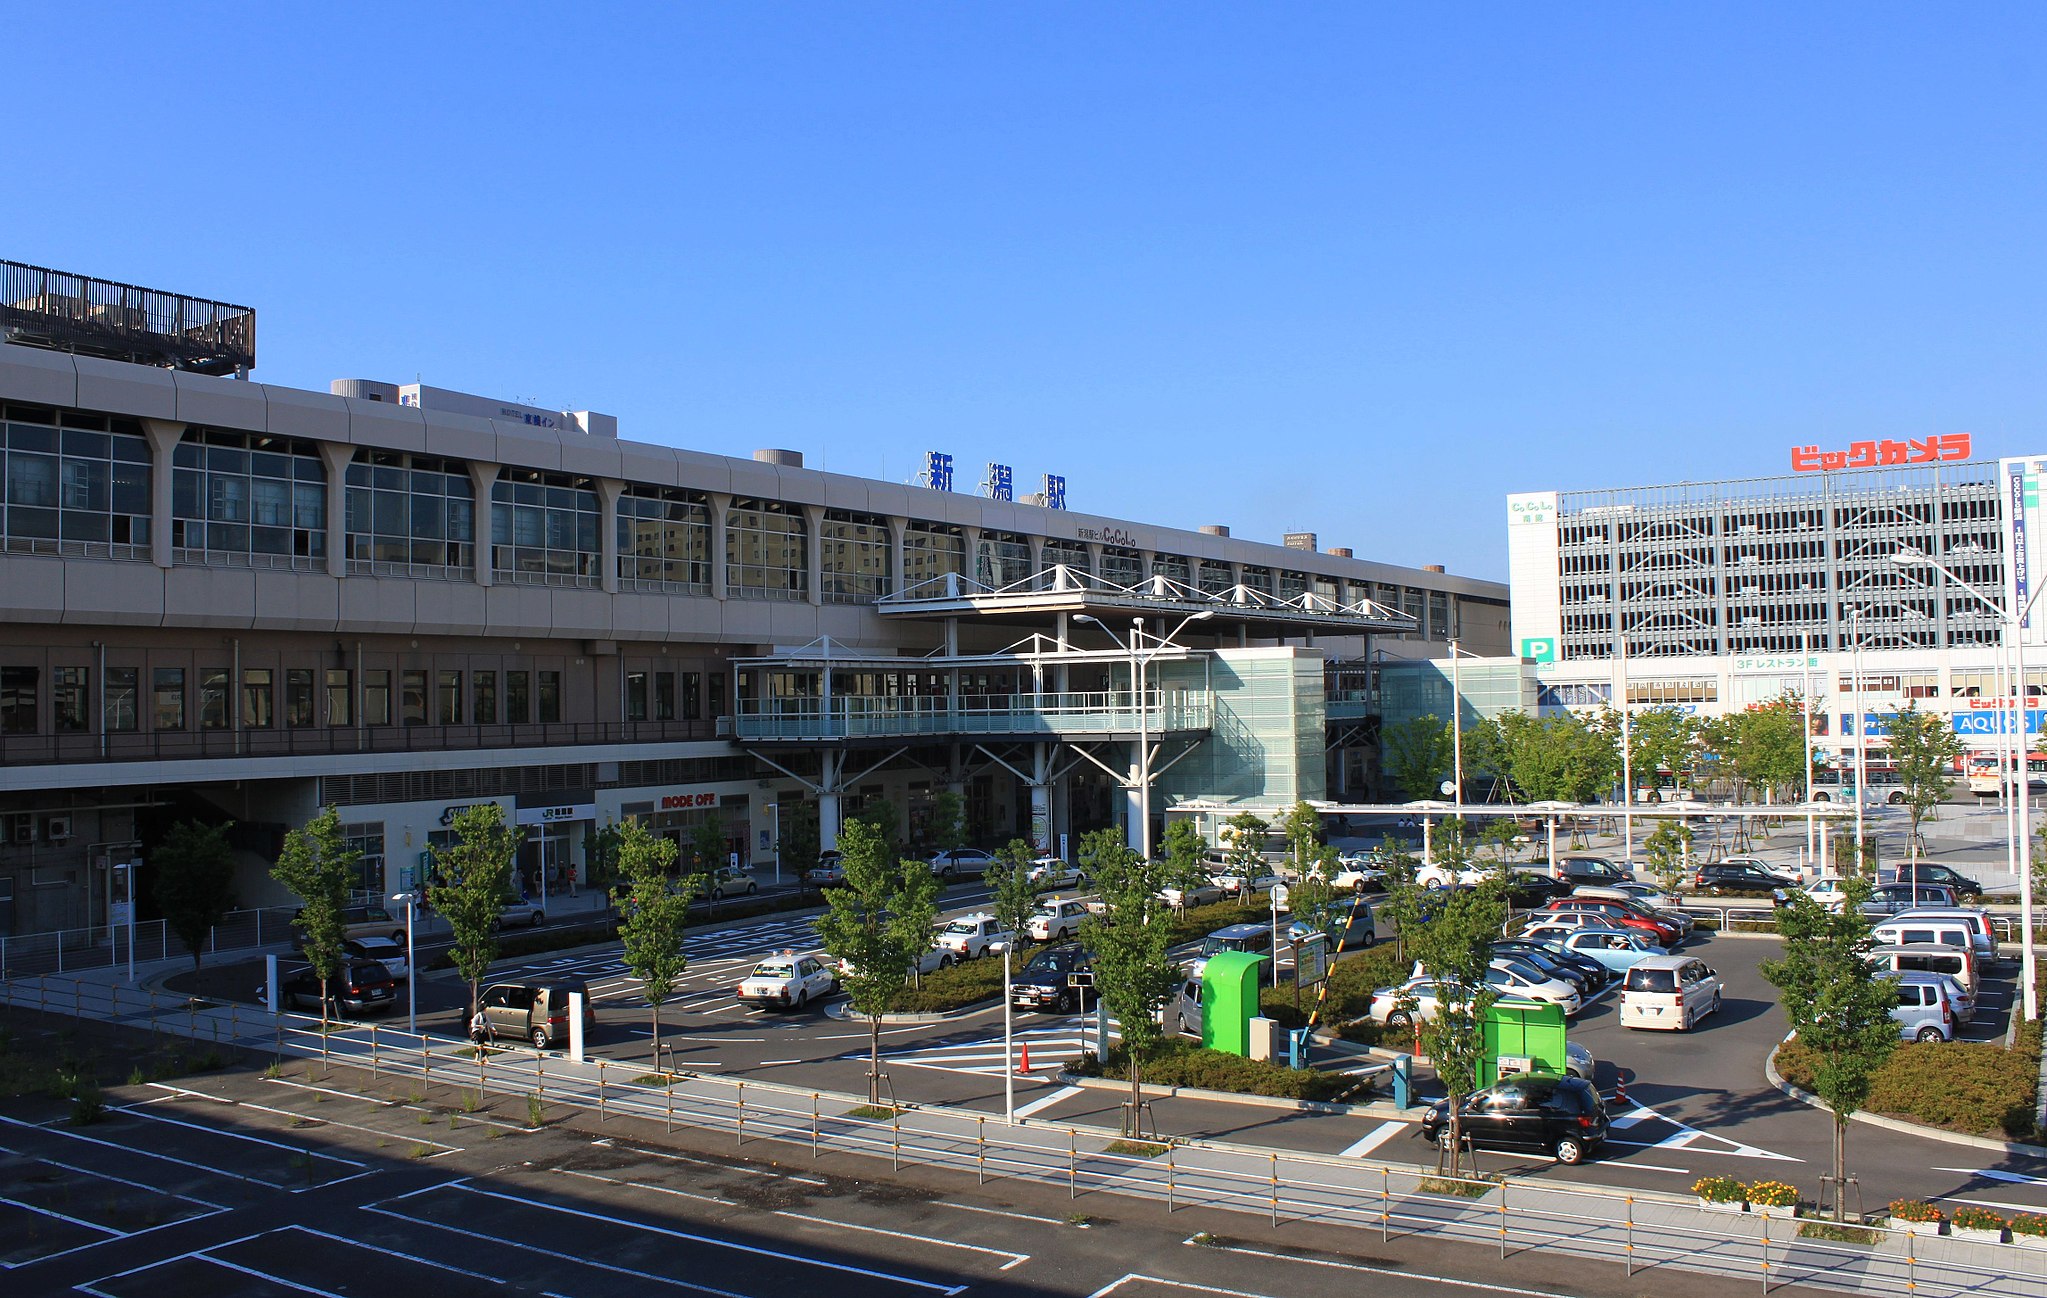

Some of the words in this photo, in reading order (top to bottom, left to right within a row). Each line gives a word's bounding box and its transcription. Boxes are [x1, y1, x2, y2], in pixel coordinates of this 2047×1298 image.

[1791, 433, 1971, 472] ビックカメラ
[1530, 641, 1548, 659] P
[1737, 659, 1753, 669] 3F
[662, 794, 693, 809] MODE
[696, 793, 715, 806] OFF
[542, 808, 554, 818] JR
